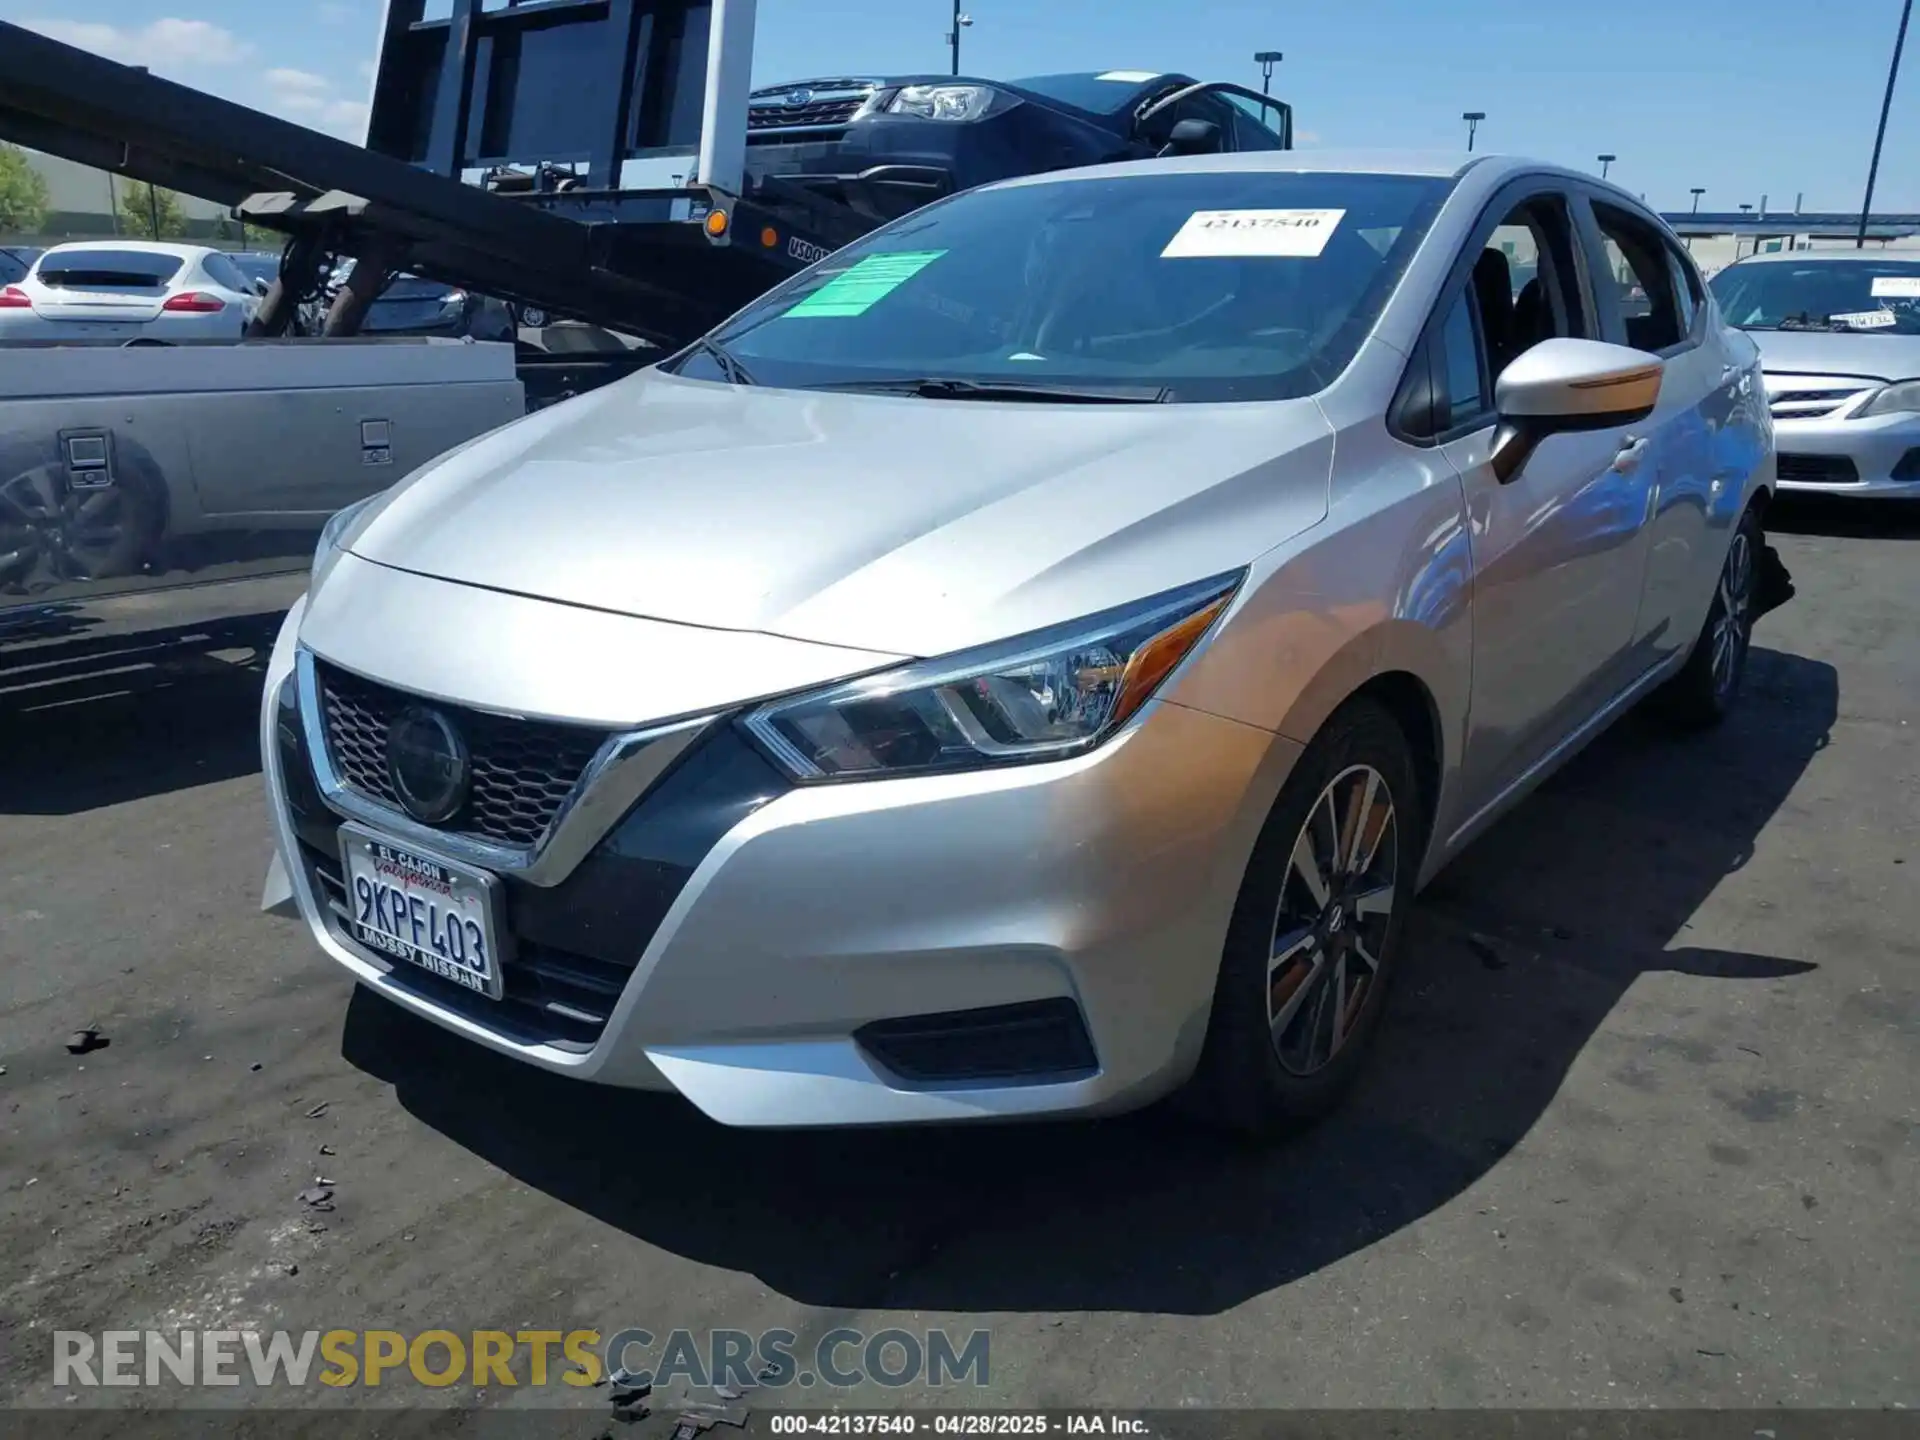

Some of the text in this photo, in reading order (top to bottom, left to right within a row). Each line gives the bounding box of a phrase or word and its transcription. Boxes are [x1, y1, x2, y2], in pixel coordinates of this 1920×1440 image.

[1199, 218, 1320, 229] 42137540
[379, 846, 441, 880] EL CAJON
[356, 876, 486, 973] 9KPF403
[363, 928, 484, 992] MOSSY NISSAN
